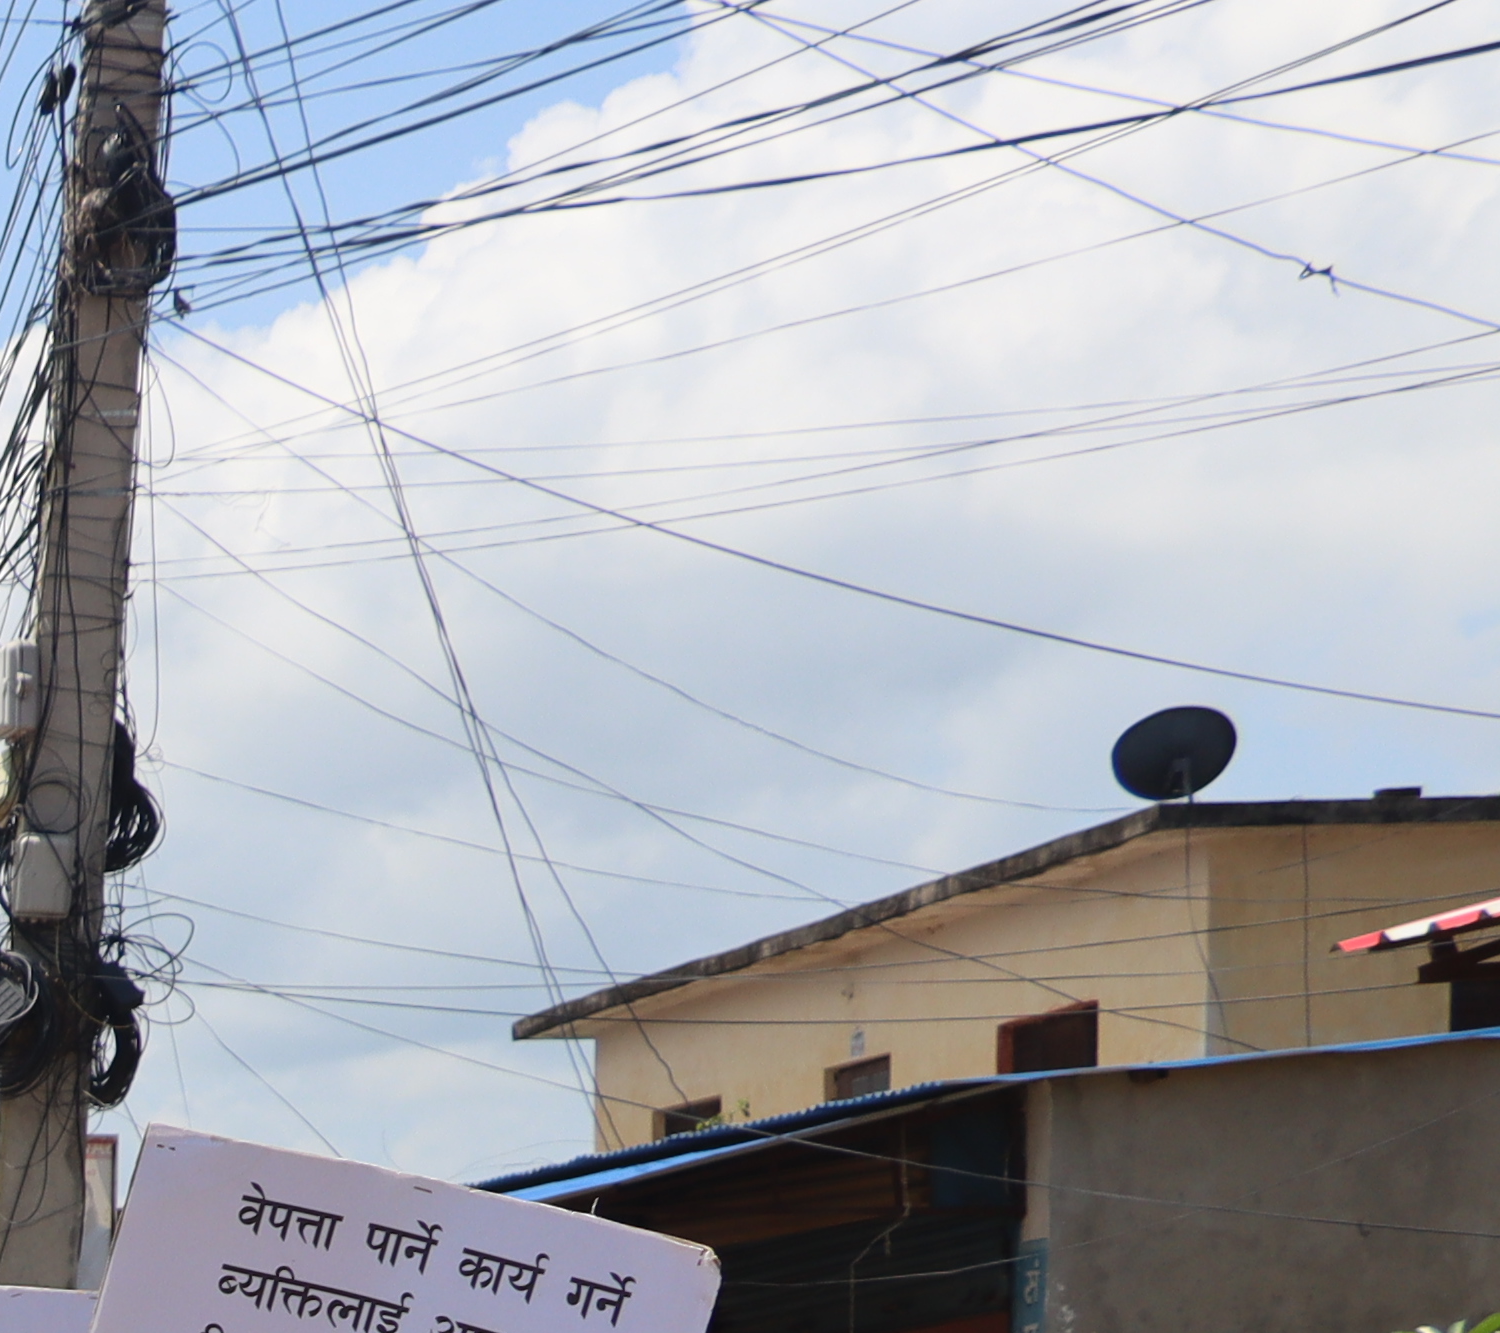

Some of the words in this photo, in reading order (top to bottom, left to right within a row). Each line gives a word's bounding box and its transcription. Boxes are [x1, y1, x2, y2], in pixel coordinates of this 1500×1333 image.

[237, 1181, 344, 1251] वेपत्ता
[366, 1219, 444, 1273] पार्ने
[457, 1245, 550, 1304] कार्य
[566, 1271, 637, 1328] गर्ने
